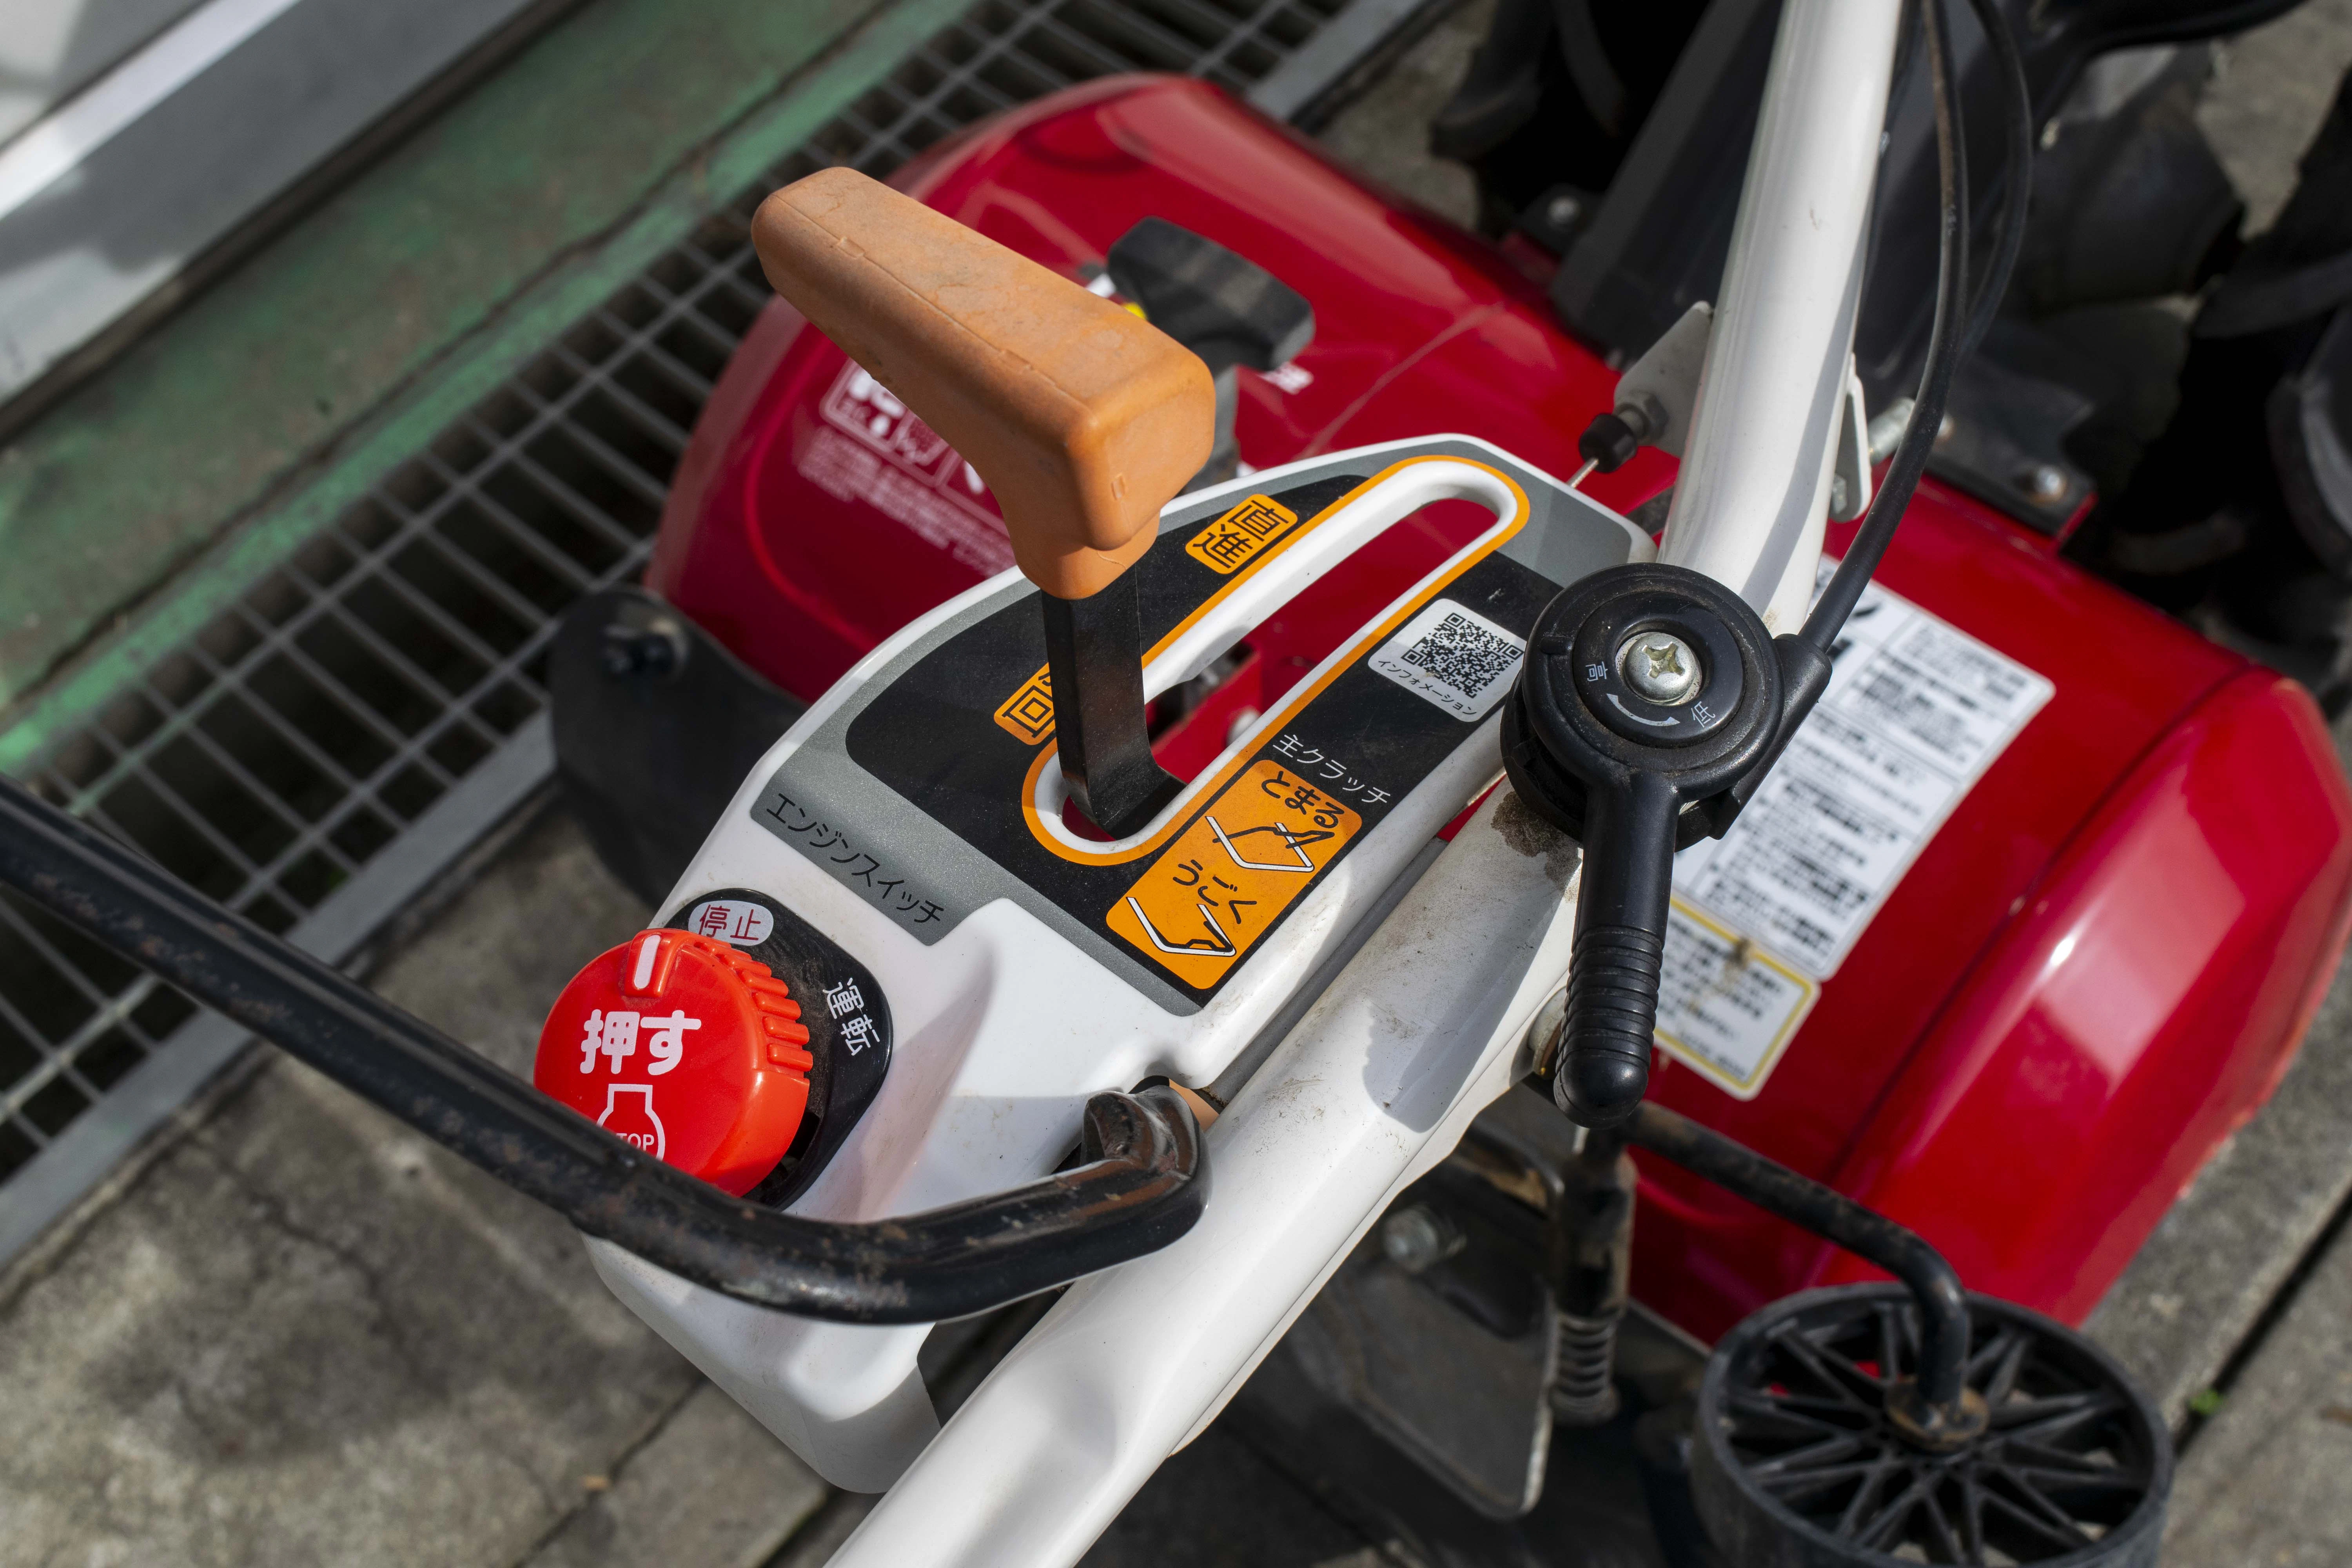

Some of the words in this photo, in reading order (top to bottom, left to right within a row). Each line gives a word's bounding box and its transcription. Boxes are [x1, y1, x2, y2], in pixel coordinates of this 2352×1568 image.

[1192, 499, 1289, 569] 直進
[1377, 659, 1477, 716] インフォメーション
[1585, 662, 1608, 682] 高
[1002, 672, 1055, 739] 回
[1691, 701, 1716, 728] 低
[1261, 771, 1345, 829] とまる
[1273, 734, 1391, 806] 主クラッチ
[767, 793, 944, 925] エンジンスイッチ
[1172, 859, 1257, 924] うごく
[699, 904, 761, 941] 停止
[580, 1009, 701, 1075] 押す
[822, 977, 880, 1056] 運転
[616, 1132, 654, 1151] TOP
